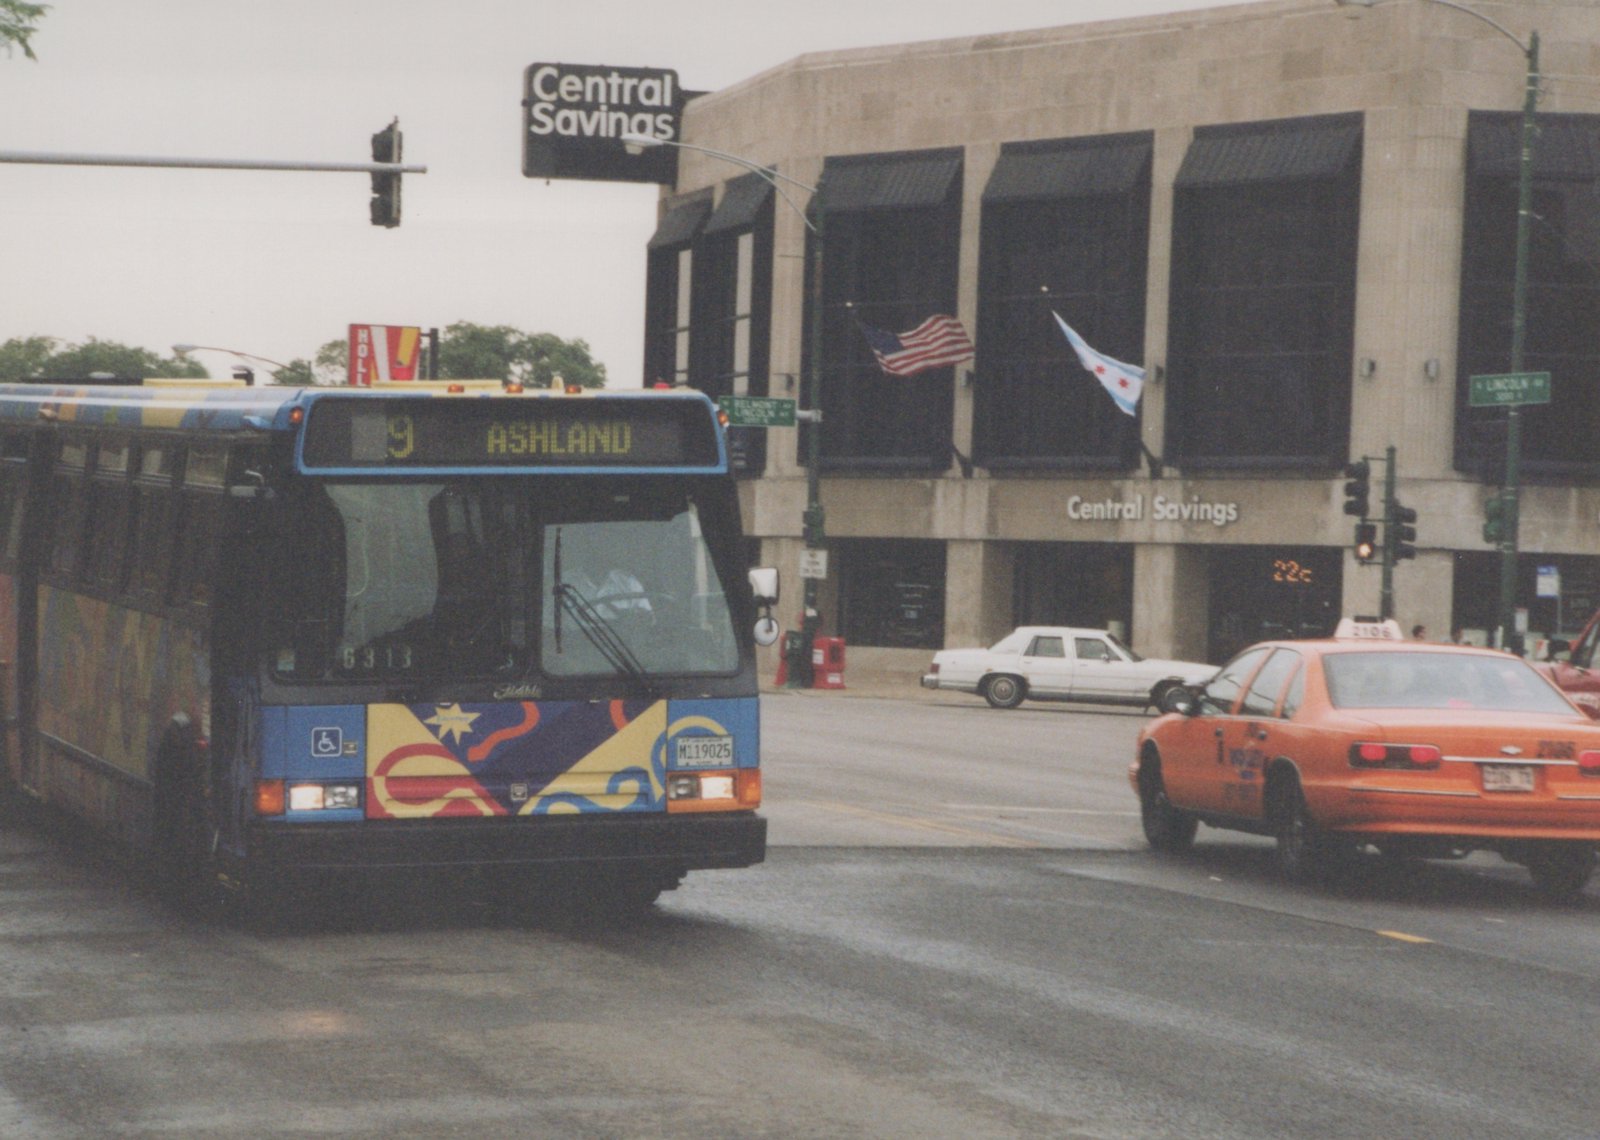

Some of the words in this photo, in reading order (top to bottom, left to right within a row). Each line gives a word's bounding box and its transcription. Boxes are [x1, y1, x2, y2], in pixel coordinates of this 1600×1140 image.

[533, 66, 672, 107] Central
[530, 102, 675, 140] Savings
[387, 414, 414, 459] 9
[486, 420, 632, 454] ASHLAND
[1067, 495, 1143, 520] Central
[1152, 495, 1238, 526] Savings
[343, 647, 413, 669] 6313
